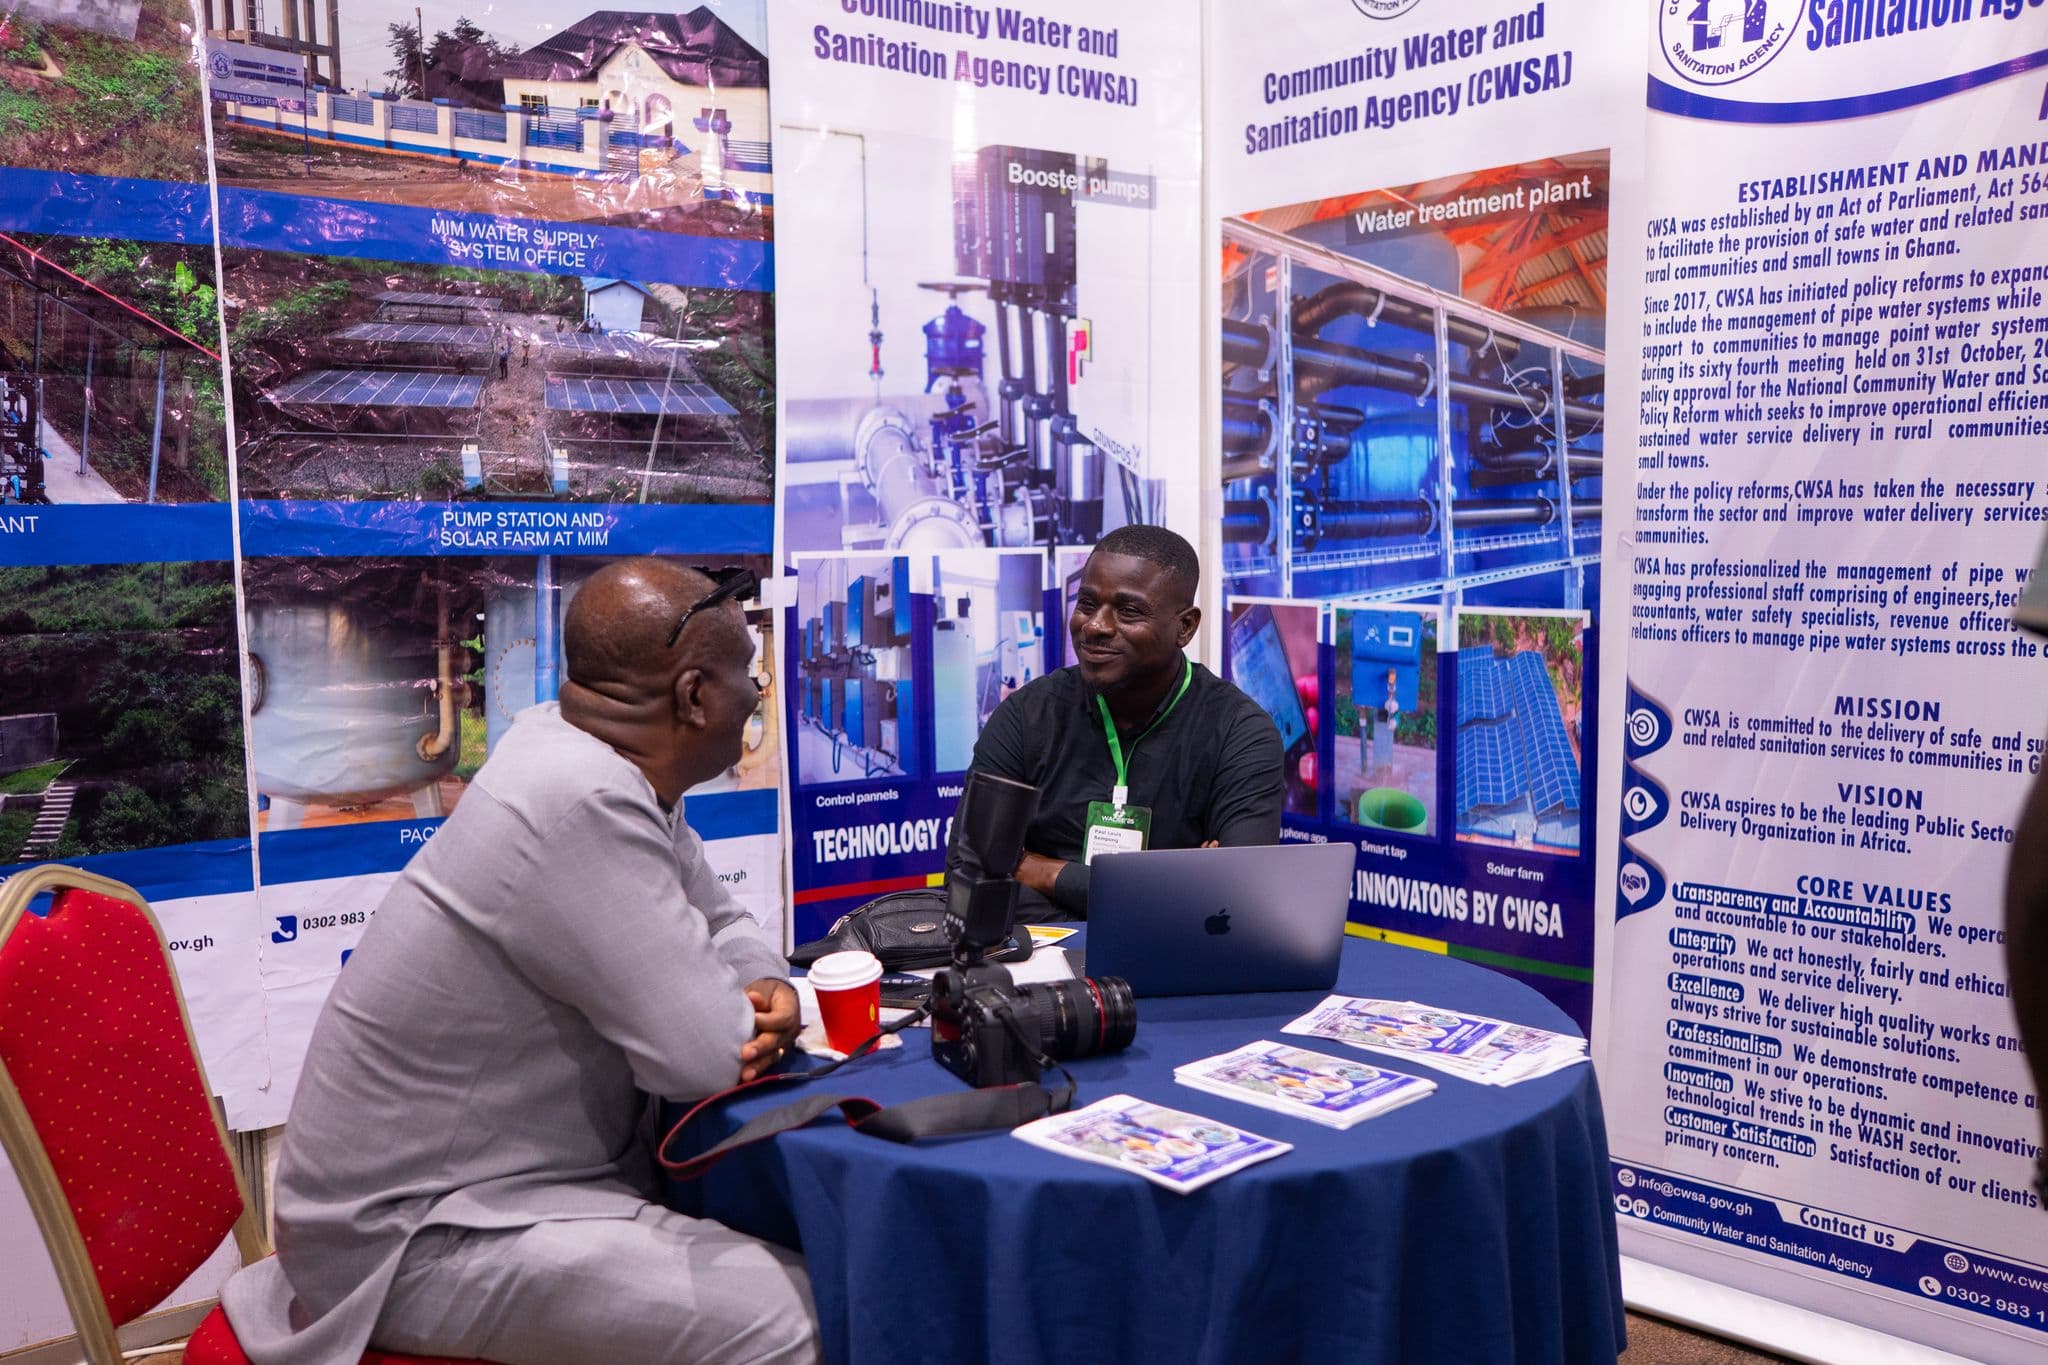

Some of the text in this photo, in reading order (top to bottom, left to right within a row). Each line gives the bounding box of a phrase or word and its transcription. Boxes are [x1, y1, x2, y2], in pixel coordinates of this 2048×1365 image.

[996, 7, 1072, 49] Water
[1078, 27, 1118, 59] and
[1673, 22, 1785, 76] SANITATION AGENCY
[814, 25, 1138, 107] Sanitation Agency (CWSA)
[1264, 2, 1545, 104] Community Water and
[1246, 50, 1573, 155] Sanitation Agency (CWSA)
[1009, 163, 1149, 202] Booster pumps
[1739, 162, 1909, 203] ESTABLISHMENT
[1916, 154, 1967, 181] AND
[1355, 175, 1592, 235] Water treatment plant
[1648, 178, 2013, 238] CWSA was established by an Act of Parliament, Act
[432, 219, 598, 250] MIM WATER SUPPLY
[450, 239, 586, 268] SYSTEM OFFICE
[1645, 270, 1985, 314] Since 2017, CWSA has initiated policy reforms to
[1641, 365, 2026, 407] policy approval for the National Community Water and
[1638, 482, 1665, 499] Under
[1670, 482, 1688, 499] the
[1694, 481, 1732, 504] policy
[1839, 479, 1863, 498] has
[1874, 478, 1914, 497] taken
[1921, 478, 1944, 497] the
[1956, 482, 2034, 501] necessary
[440, 531, 608, 547] SOLAR FARM AT MIM
[443, 511, 605, 528] PUMP STATION AND
[1632, 622, 2036, 657] relations officers to manage pipe water systems across the
[1834, 696, 1940, 722] MISSION
[816, 786, 964, 807] Control pannels Wate
[1681, 791, 1964, 837] CWSA aspires to be the leading Public
[1838, 783, 1922, 810] VISION
[401, 826, 439, 844] PAC
[813, 818, 941, 864] TECHNOLOGY
[1284, 828, 1310, 841] phone
[1361, 840, 1407, 860] Smart tap
[1681, 811, 1911, 853] Delivery Organization in Africa.
[1486, 861, 1544, 882] Solar farm
[1357, 870, 1467, 922] INNOVATONS
[1473, 892, 1498, 927] BY
[1502, 894, 1564, 939] CWSA
[1676, 882, 1912, 934] Transparency and Accountability
[1797, 875, 1951, 913] CORE VALUES
[303, 915, 336, 930] 0302
[341, 912, 365, 925] 983
[1675, 904, 1946, 958] and accountable to our stakeholders.
[1673, 927, 1734, 955] Integrity
[1671, 973, 1740, 1001] Excellence
[1669, 1020, 1779, 1058] Professionalism
[1667, 1063, 1731, 1092] Inovation
[1665, 1106, 1815, 1157] Customer Satisfaction
[1666, 1085, 1961, 1164] technological trends in the WASH sector.
[1665, 1131, 1779, 1168] primary concern.
[1638, 1175, 1753, 1216] info@cwsa.gov.gh
[1653, 1205, 1872, 1278] Community Water and Sanitation Agency
[1800, 1207, 1894, 1247] Contact us
[1946, 1284, 1991, 1308] 0302
[1996, 1299, 2029, 1318] 983
